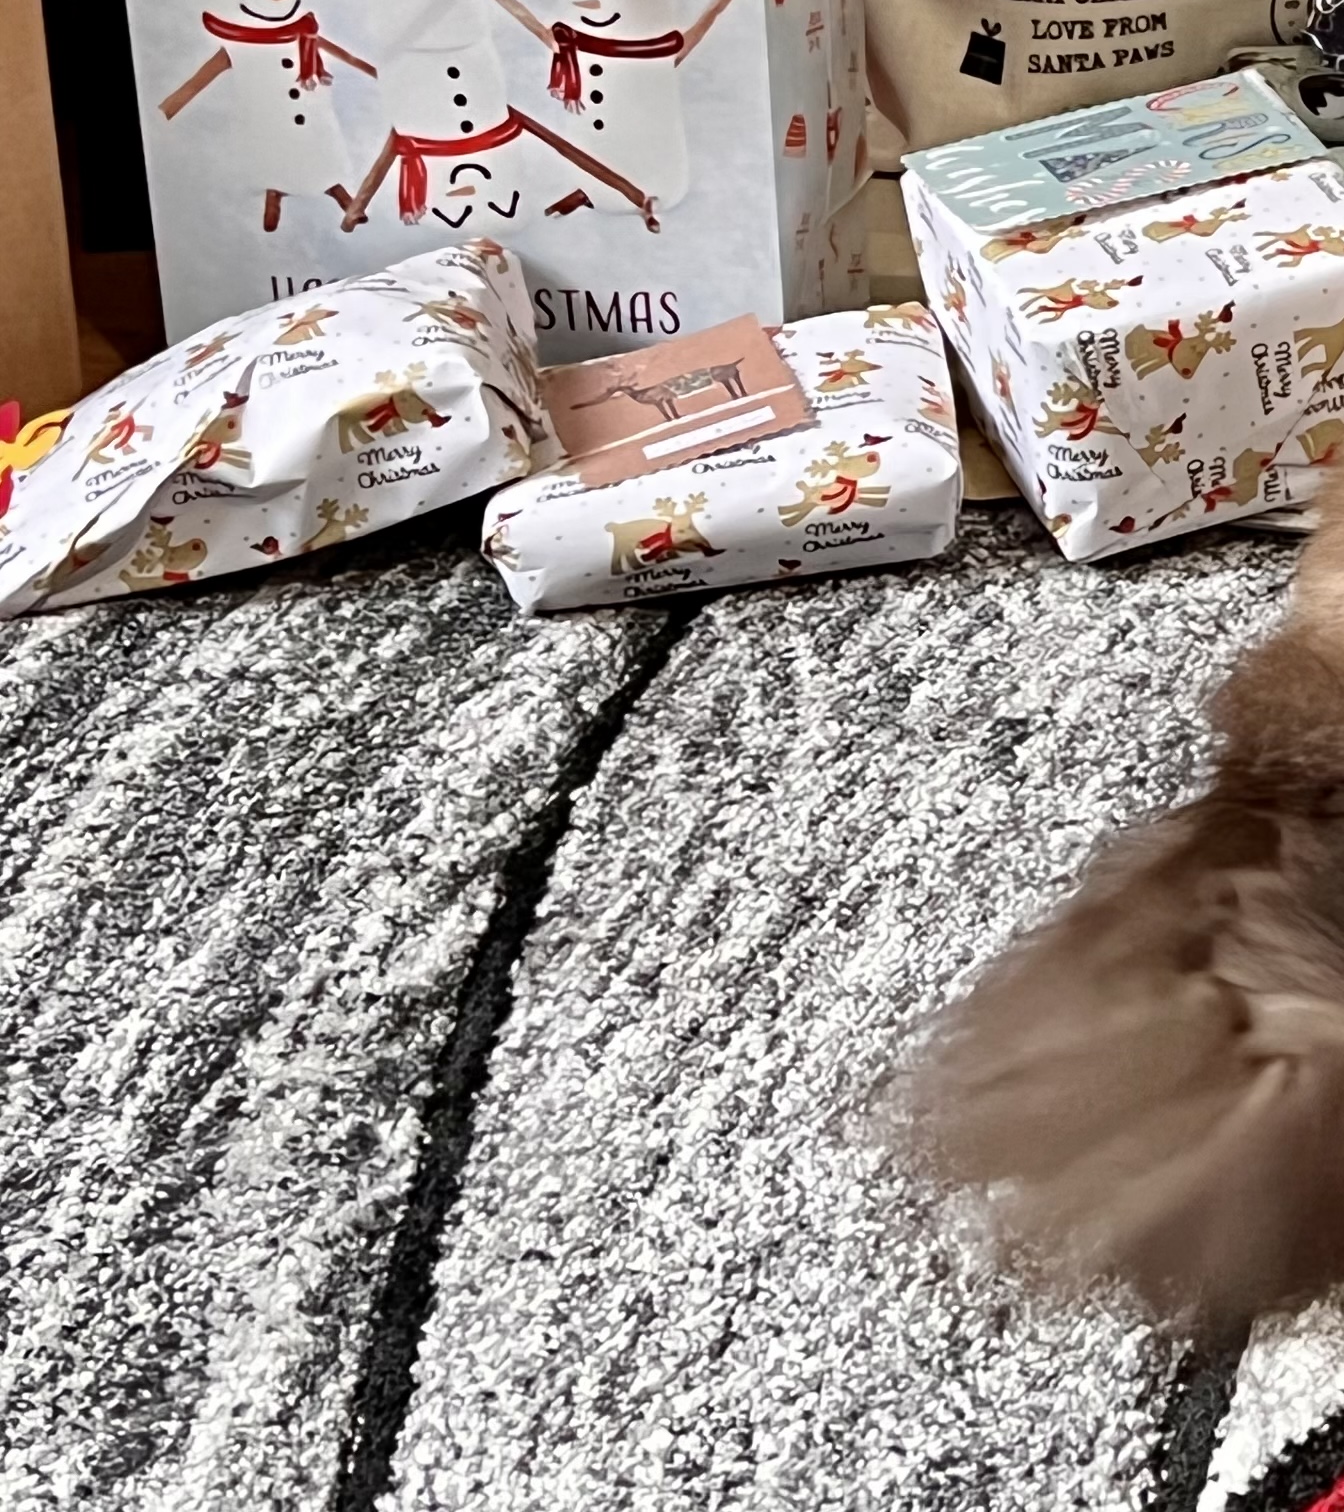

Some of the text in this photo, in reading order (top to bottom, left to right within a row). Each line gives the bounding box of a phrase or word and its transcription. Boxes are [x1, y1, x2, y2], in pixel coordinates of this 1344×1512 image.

[1031, 18, 1095, 41] LOVE
[1027, 40, 1176, 74] SANTA PAWS
[534, 288, 682, 336] STMAS
[357, 445, 422, 467] Merry
[1048, 444, 1110, 466] Merry
[804, 520, 871, 537] Merry
